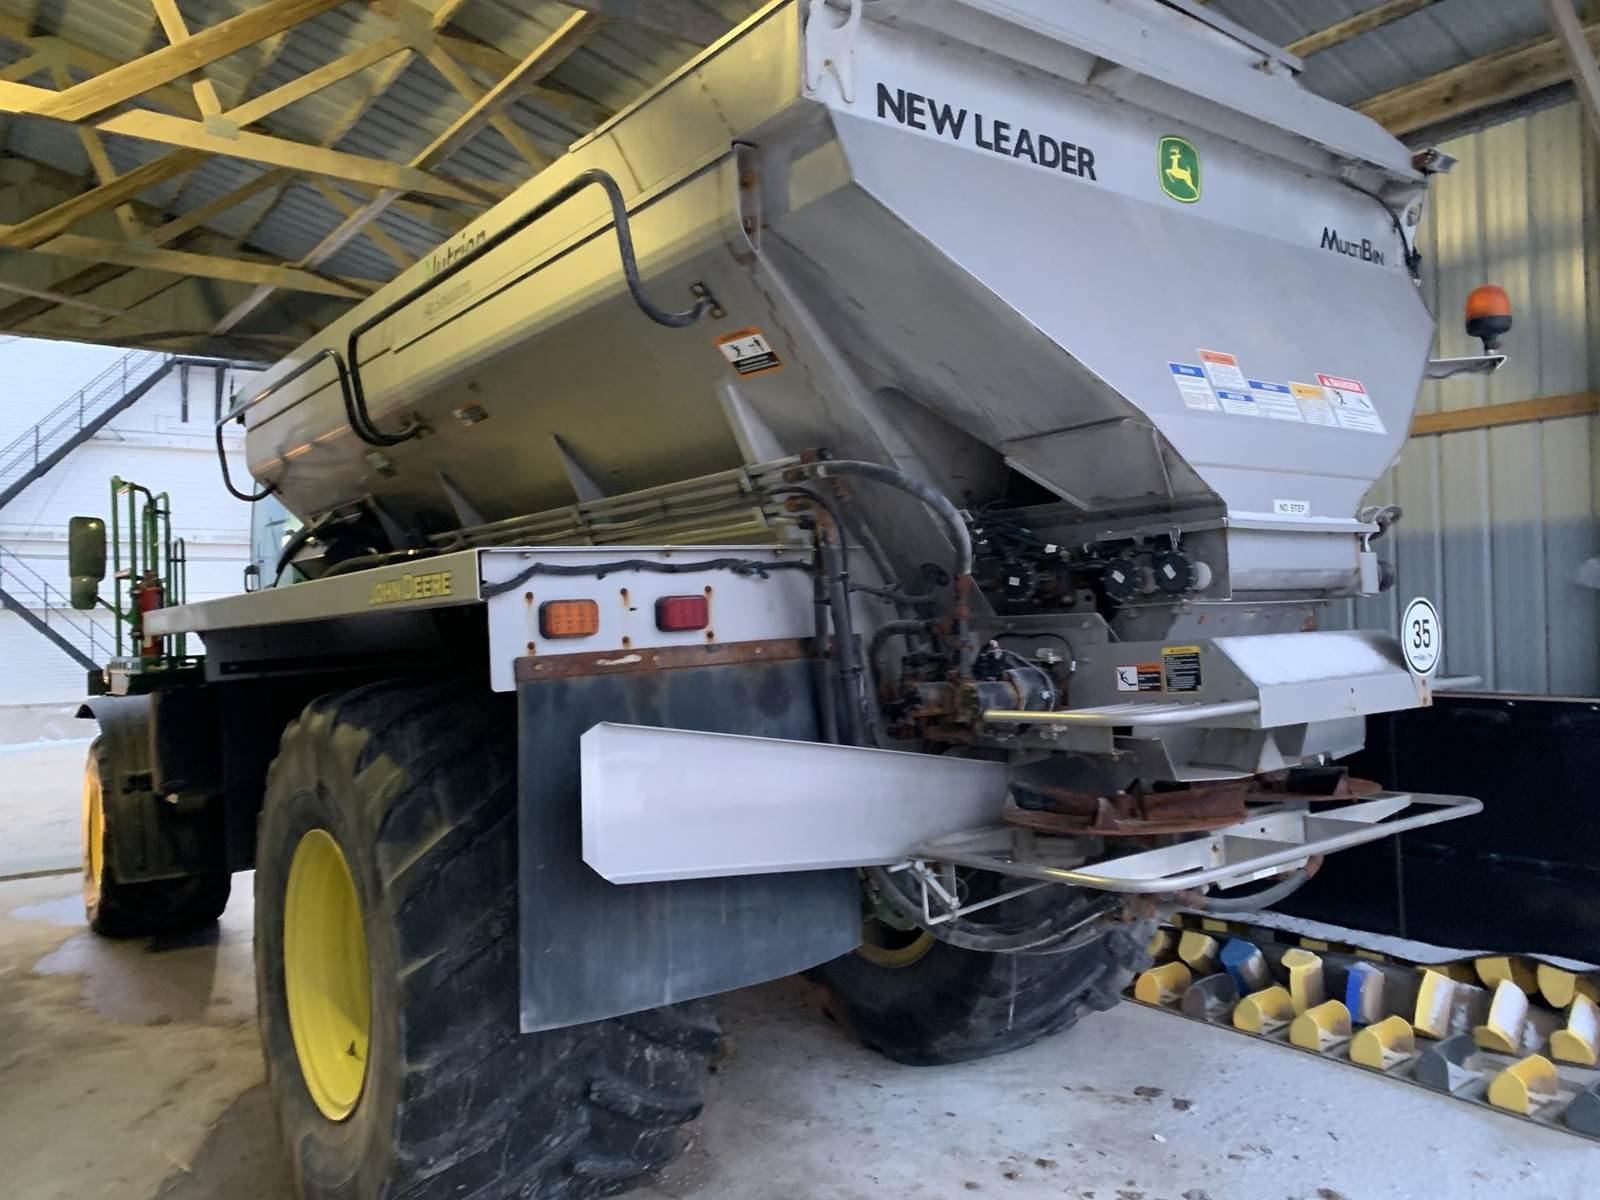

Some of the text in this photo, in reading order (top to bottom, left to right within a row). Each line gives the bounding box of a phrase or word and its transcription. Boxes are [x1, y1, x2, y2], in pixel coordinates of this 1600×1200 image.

[876, 82, 1096, 181] NEW LEADER
[402, 573, 451, 600] DEERE
[1412, 619, 1431, 649] 35
